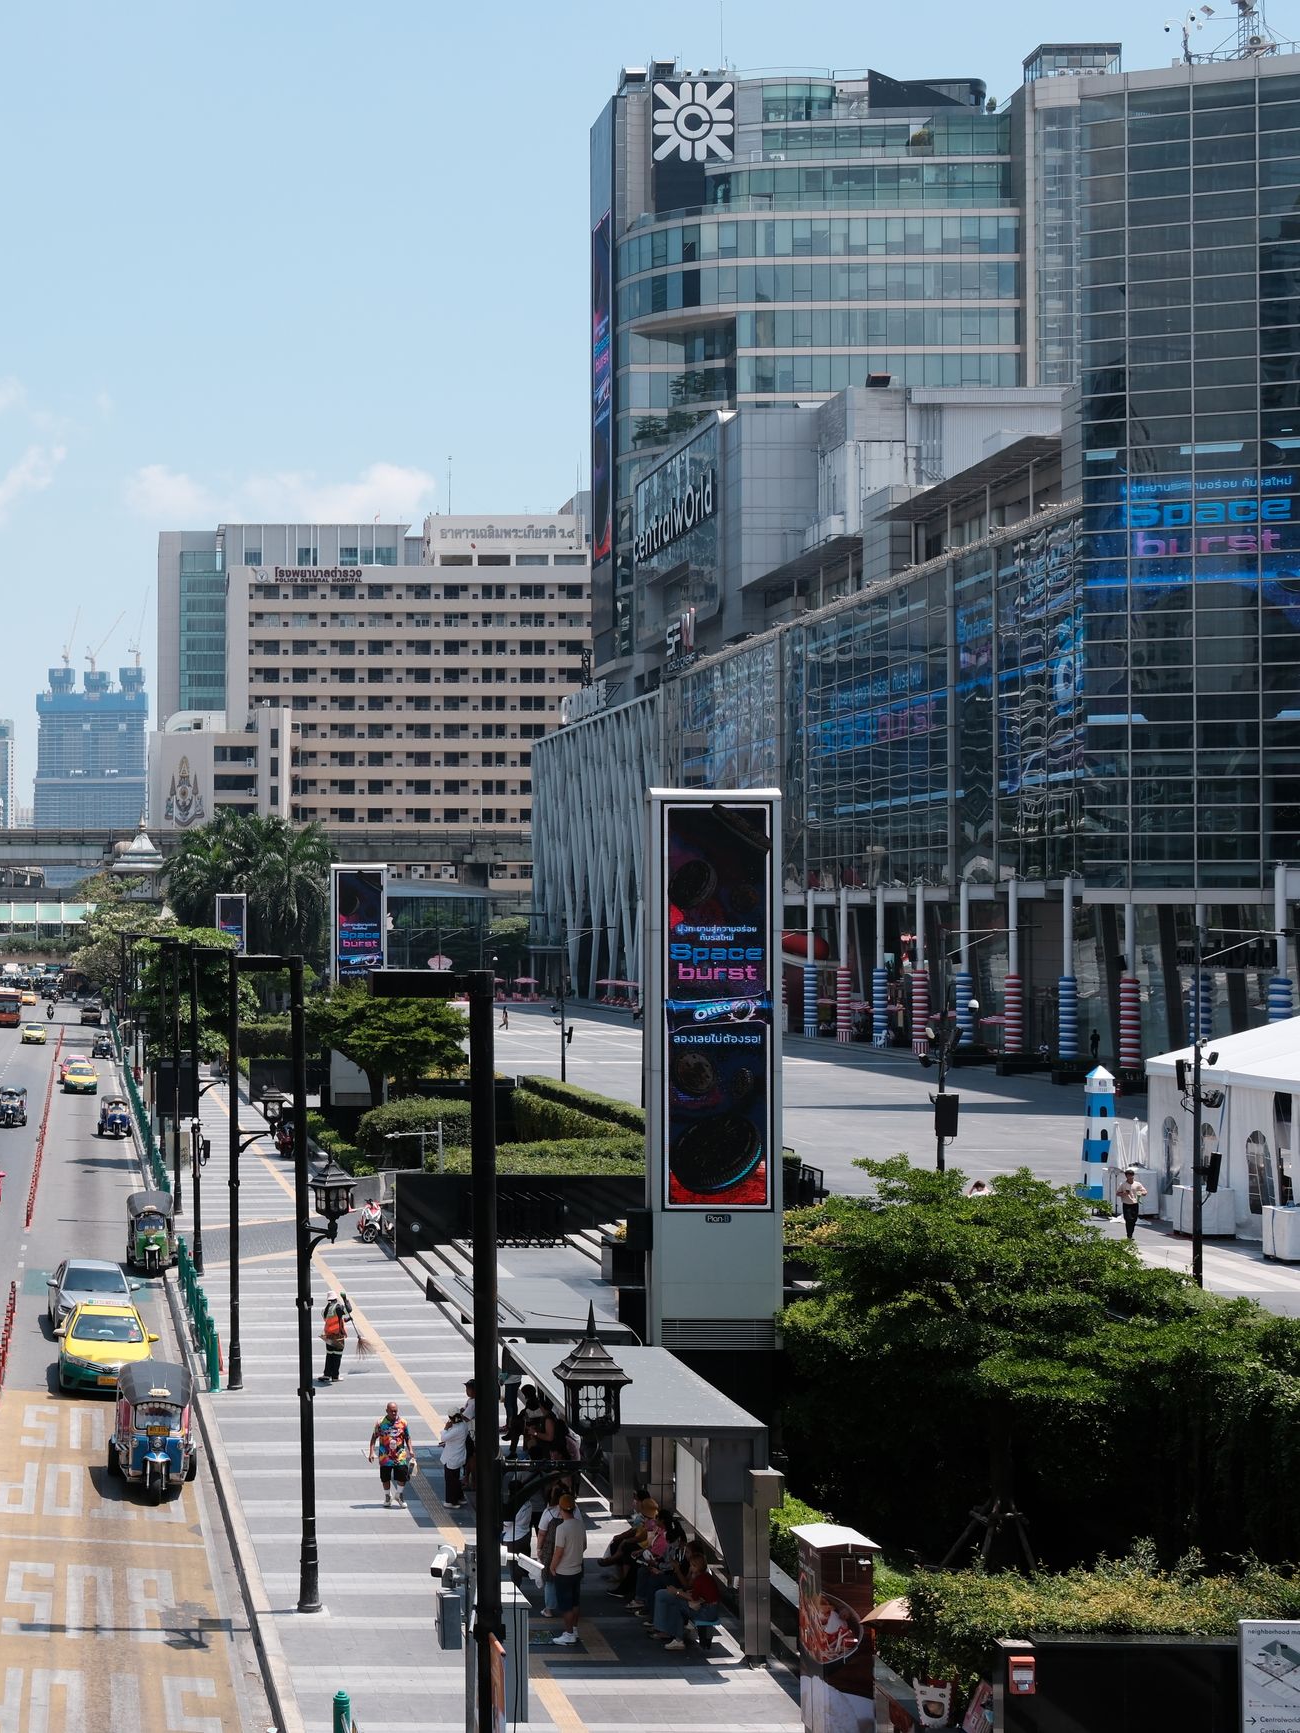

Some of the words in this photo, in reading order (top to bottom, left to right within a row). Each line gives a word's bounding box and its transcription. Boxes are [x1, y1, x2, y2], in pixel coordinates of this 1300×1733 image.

[1136, 529, 1281, 557] burst
[670, 943, 763, 965] Space
[678, 963, 757, 980] burst
[694, 1004, 731, 1020] OREO
